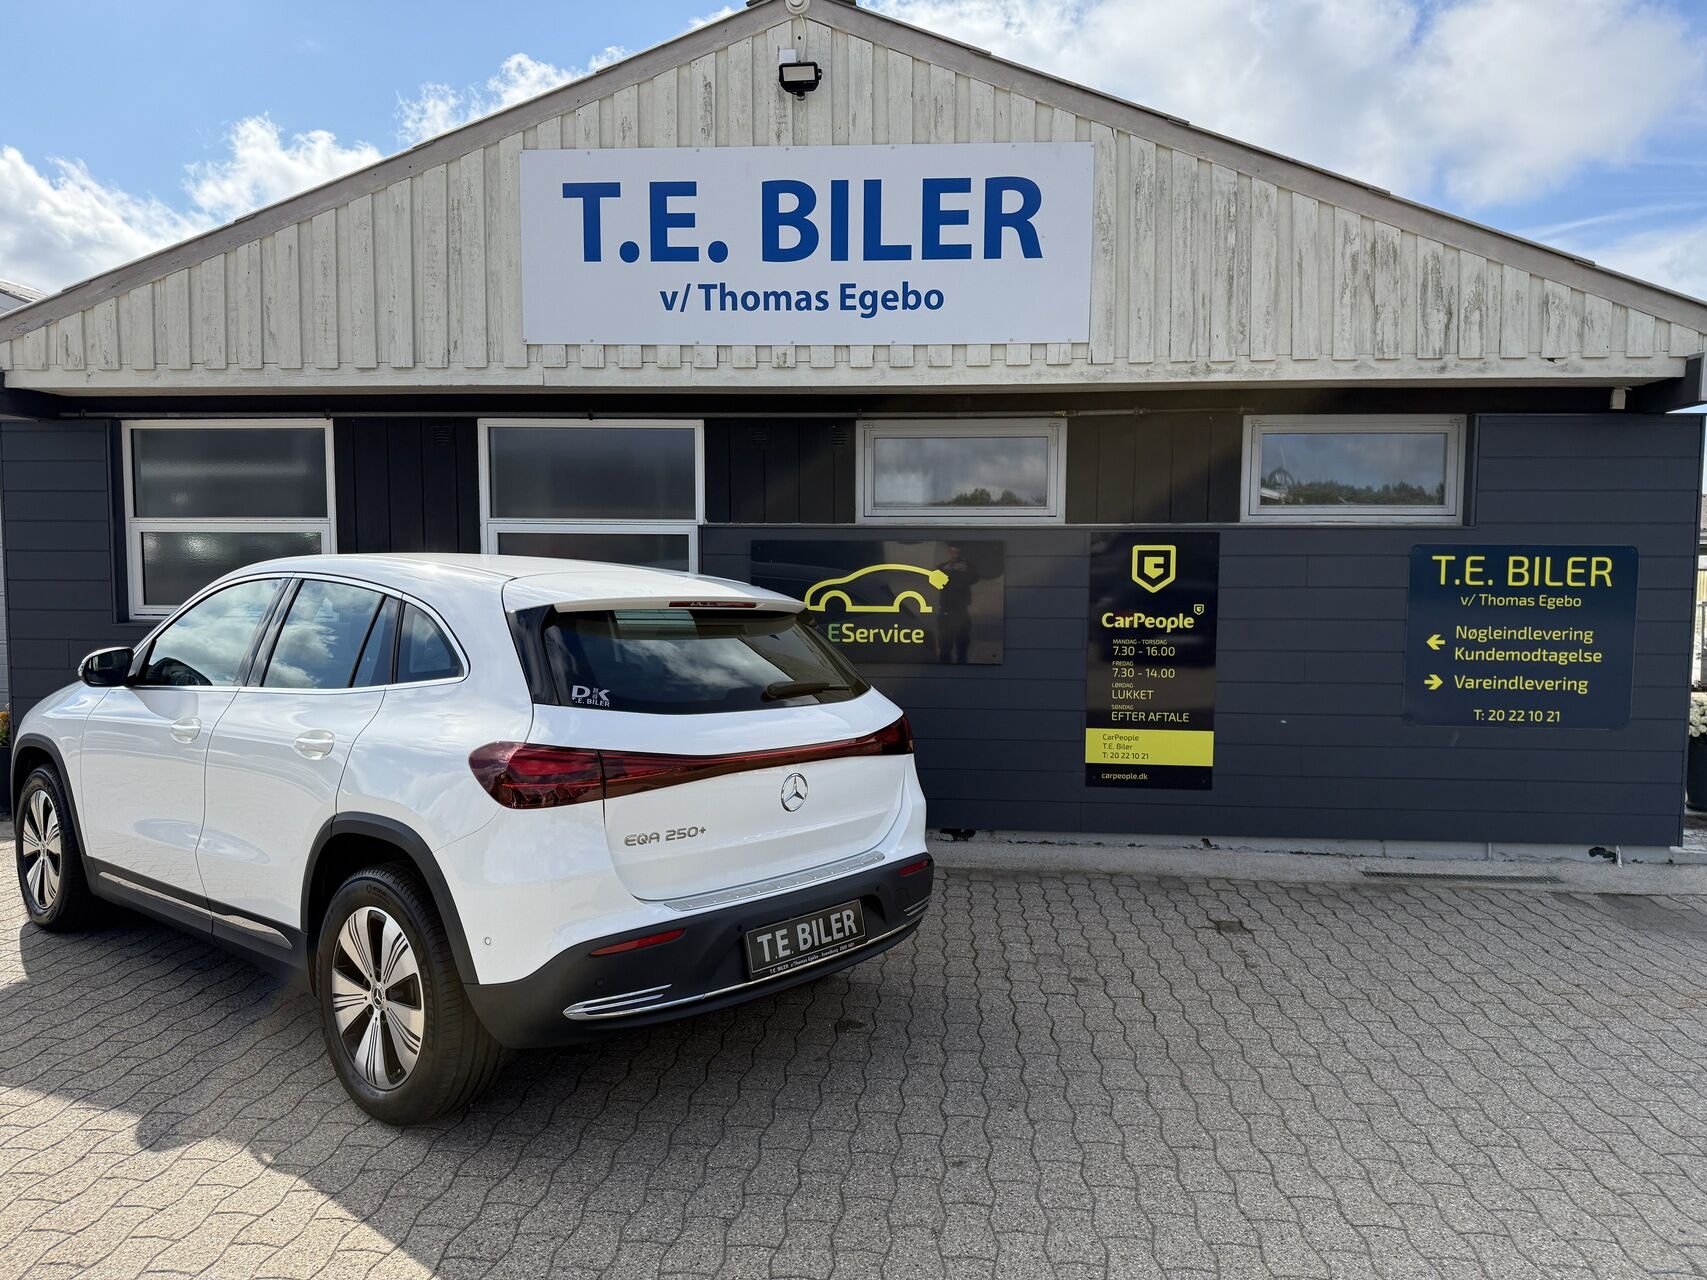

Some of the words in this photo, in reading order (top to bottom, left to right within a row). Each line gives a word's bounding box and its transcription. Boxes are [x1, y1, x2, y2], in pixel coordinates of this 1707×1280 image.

[562, 181, 728, 264] T.E.
[761, 176, 1044, 262] BILER
[660, 282, 691, 313] v/
[698, 283, 830, 312] Thomas
[839, 281, 945, 318] Egebo
[1432, 555, 1494, 586] T.E.
[1507, 556, 1613, 587] BILER
[1460, 594, 1476, 607] v/
[1479, 594, 1535, 607] Thomas
[1539, 595, 1582, 610] Egebo
[1101, 612, 1195, 633] CarPeople
[828, 623, 925, 644] EService
[1455, 625, 1594, 644] Nøgleindlevering
[1112, 646, 1135, 656] 7.30
[1145, 646, 1176, 657] 16.00
[1454, 647, 1603, 665] Kundemodtagelse
[1112, 667, 1135, 678] 7.30
[1145, 668, 1176, 678] 14.00
[1454, 674, 1589, 695] Vareindlevering
[586, 698, 610, 707] BILER
[1111, 690, 1154, 700] LUKKET
[1111, 711, 1146, 722] EFTER
[1148, 712, 1190, 723] AFTALE
[1473, 709, 1485, 721] T:
[1488, 710, 1505, 721] 20
[1508, 710, 1525, 722] 22
[1528, 710, 1543, 722] 10
[1546, 711, 1560, 722] 21
[1102, 733, 1140, 743] CarPeople
[1102, 742, 1116, 750] T.E.
[1117, 743, 1133, 751] Biler
[1102, 751, 1108, 759] T:
[1109, 751, 1119, 760] 20
[1120, 752, 1130, 760] 22
[1131, 752, 1140, 760] 10
[1141, 752, 1149, 760] 21
[1101, 771, 1148, 781] carpeople.dk
[624, 832, 660, 847] EQA
[665, 826, 707, 841] 250+
[797, 909, 858, 952] BILER
